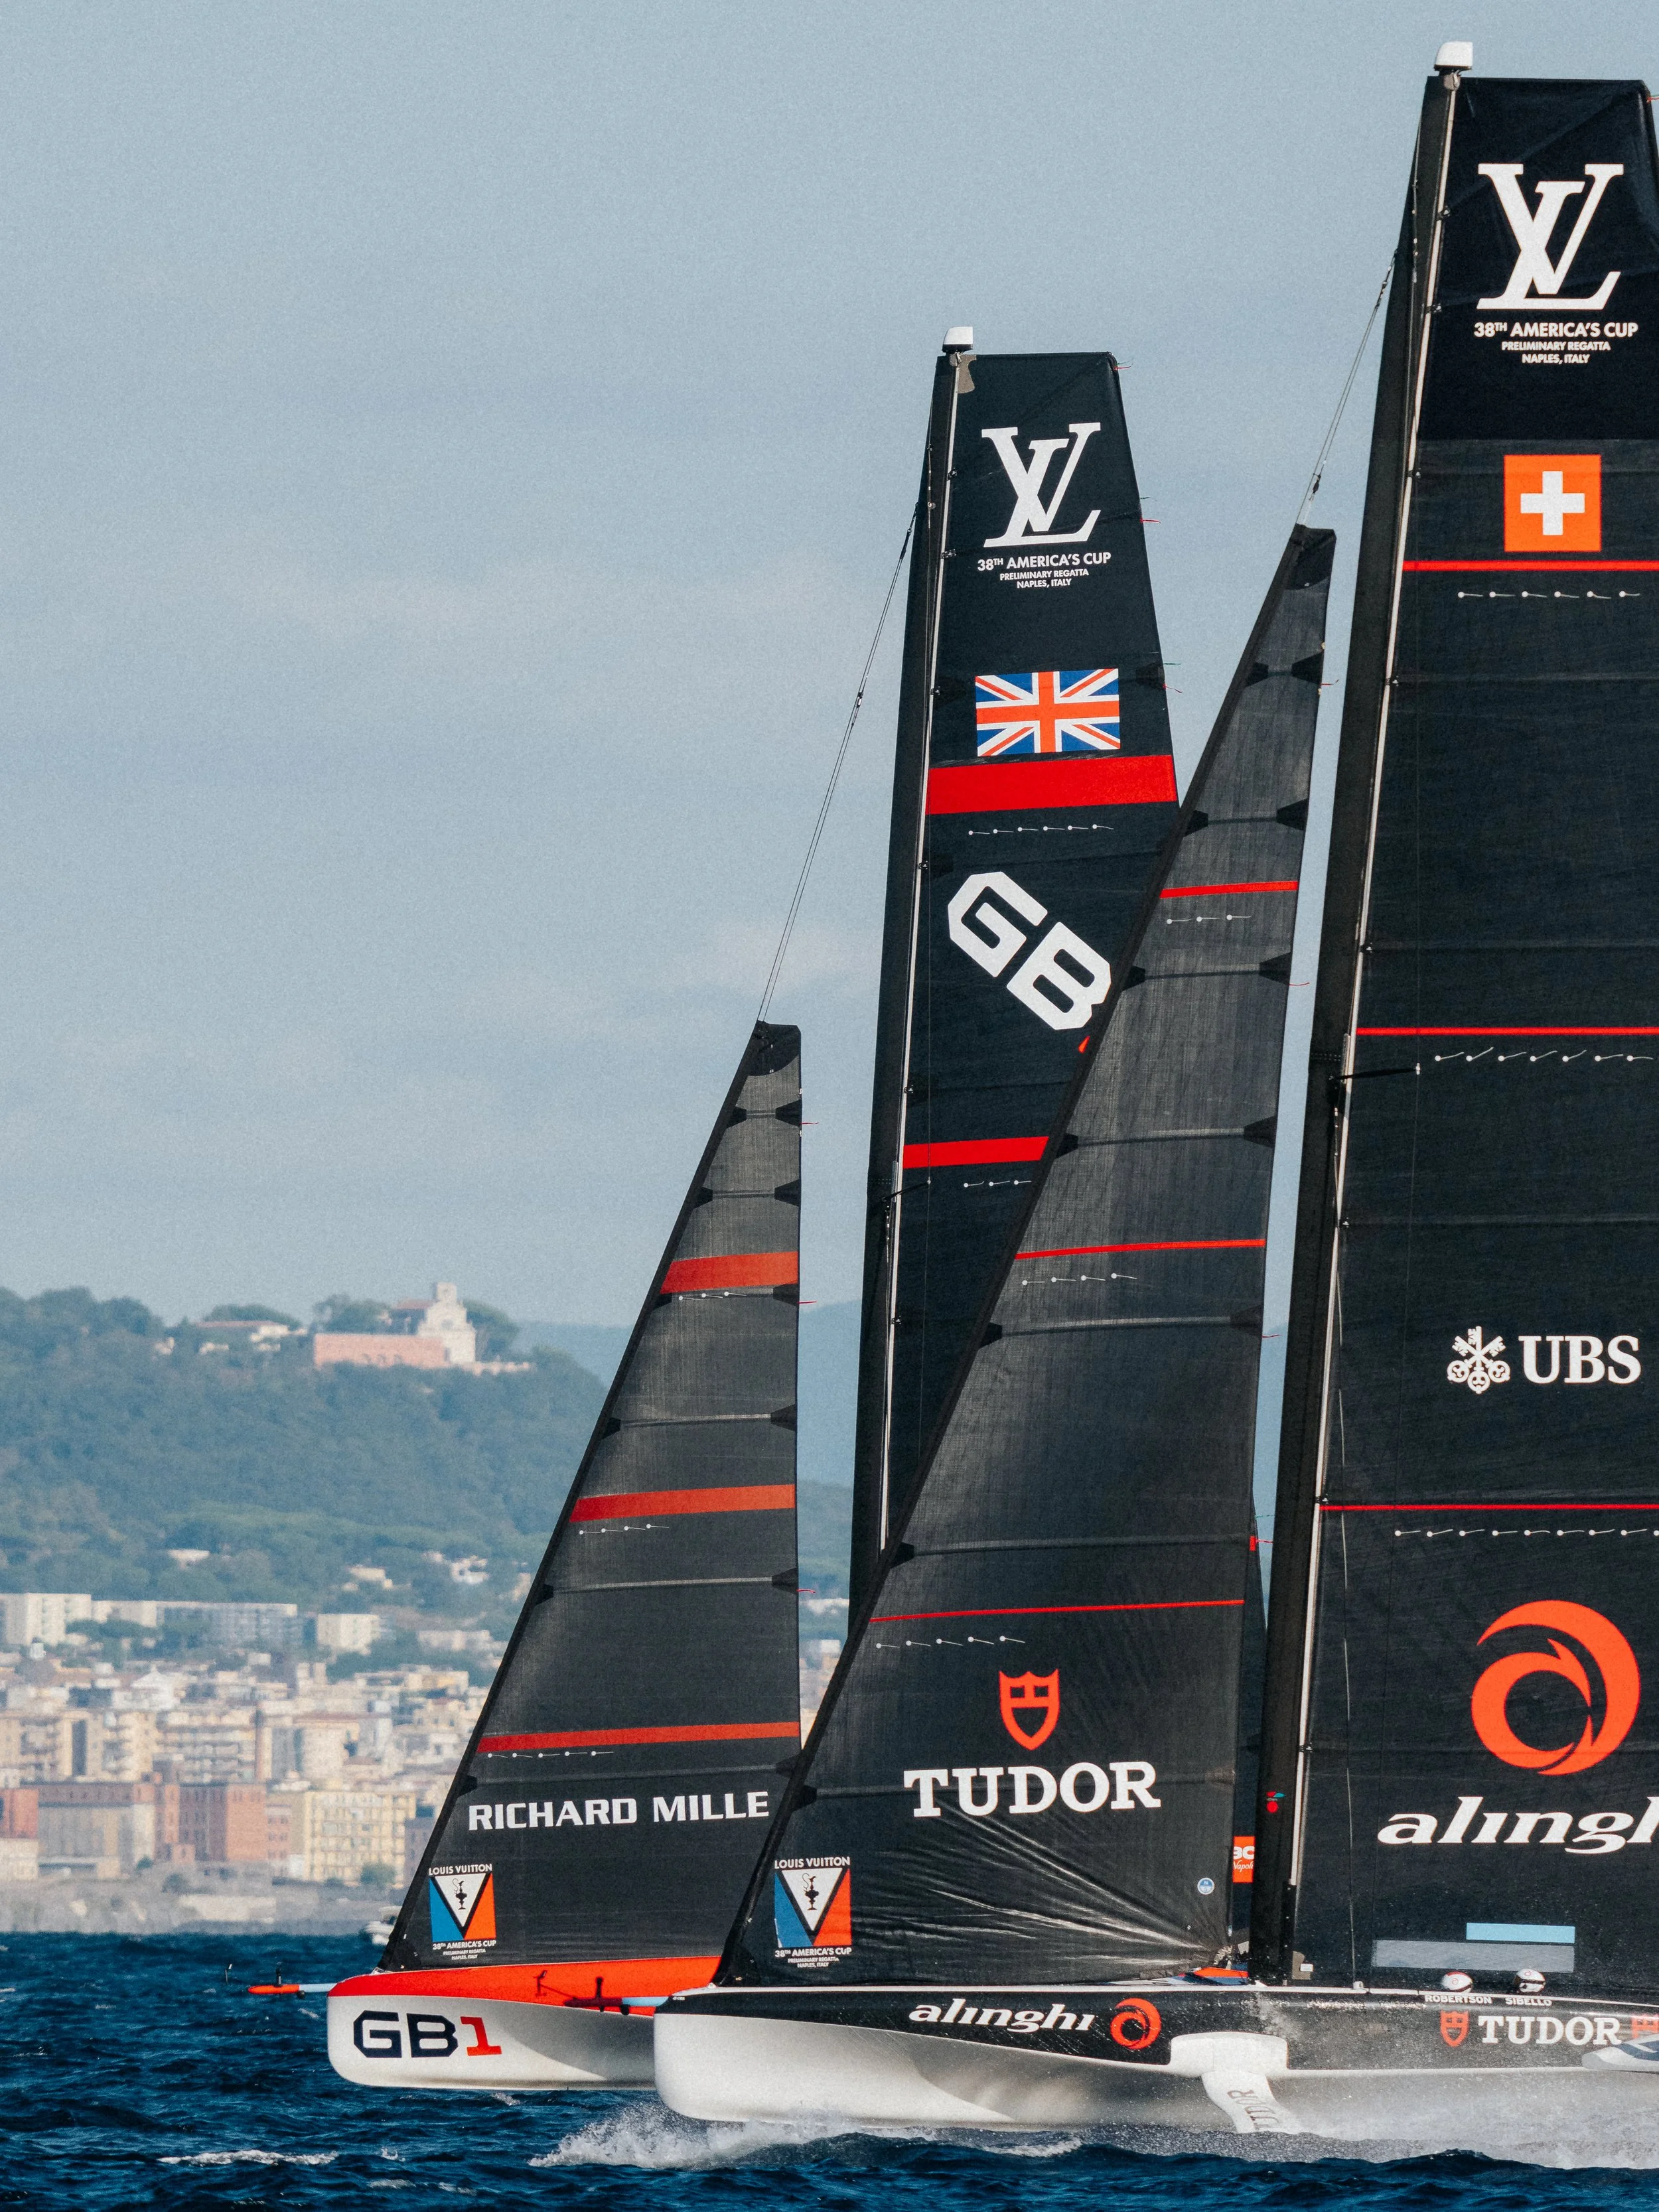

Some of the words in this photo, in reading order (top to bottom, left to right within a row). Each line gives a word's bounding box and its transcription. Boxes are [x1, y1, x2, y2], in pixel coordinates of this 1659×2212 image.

[1474, 322, 1507, 337] 38TH
[1510, 322, 1601, 337] AMERICA'S
[1603, 322, 1638, 337] CUP
[1501, 341, 1566, 351] PRELIMINARY
[1567, 341, 1611, 350] REGATTA
[1522, 354, 1563, 364] NAPLES,
[1564, 354, 1590, 363] ITALY
[977, 558, 1003, 571] 38TH
[1007, 553, 1080, 569] AMERICA'S
[1083, 552, 1111, 564] CUP
[999, 571, 1052, 581] PRELIMINARY
[1054, 569, 1089, 577] REGATTA
[1017, 579, 1049, 588] NAPLES,
[1050, 578, 1072, 587] ITALY
[948, 871, 1112, 1054] GB
[1518, 1335, 1641, 1385] UBS
[903, 1761, 1161, 1817] TUDOR
[469, 1797, 638, 1831] RICHARD
[652, 1791, 769, 1824] MILLE
[429, 1866, 454, 1876] LOUIS
[455, 1863, 493, 1874] VUITTON
[774, 1858, 804, 1869] LOUIS
[806, 1856, 850, 1867] VUITTON
[447, 1941, 482, 1949] AMERICA'S
[775, 1949, 791, 1958] 38TH
[792, 1948, 834, 1957] AMERICA'S
[835, 1947, 852, 1955] CUP
[1425, 1994, 1492, 2004] ROBERTSON
[1505, 1996, 1552, 2006] SIBELLO
[908, 1998, 1096, 2034] alinghi
[353, 2010, 503, 2058] GB1
[1478, 2015, 1622, 2045] TUDOR
